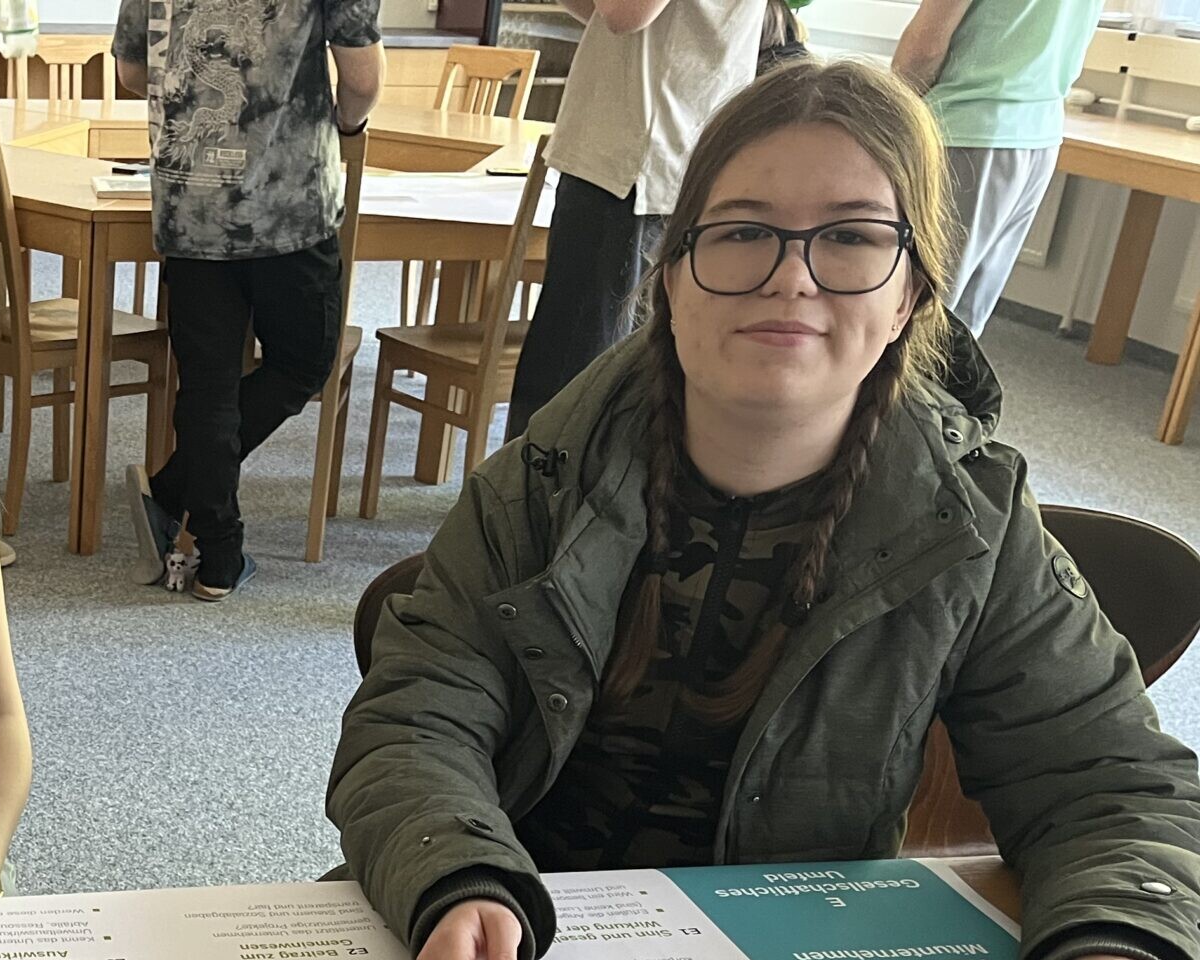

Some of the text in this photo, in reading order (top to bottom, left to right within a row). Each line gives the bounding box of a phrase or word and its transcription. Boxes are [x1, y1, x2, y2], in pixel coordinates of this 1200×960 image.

[763, 871, 846, 883] Umfeld
[715, 879, 920, 898] Gesellschaftliches
[825, 897, 847, 908] E
[240, 939, 353, 950] Gemeinwesen
[279, 950, 339, 959] Beitrag
[346, 947, 369, 956] E2
[793, 944, 989, 960] Mitunternehmen
